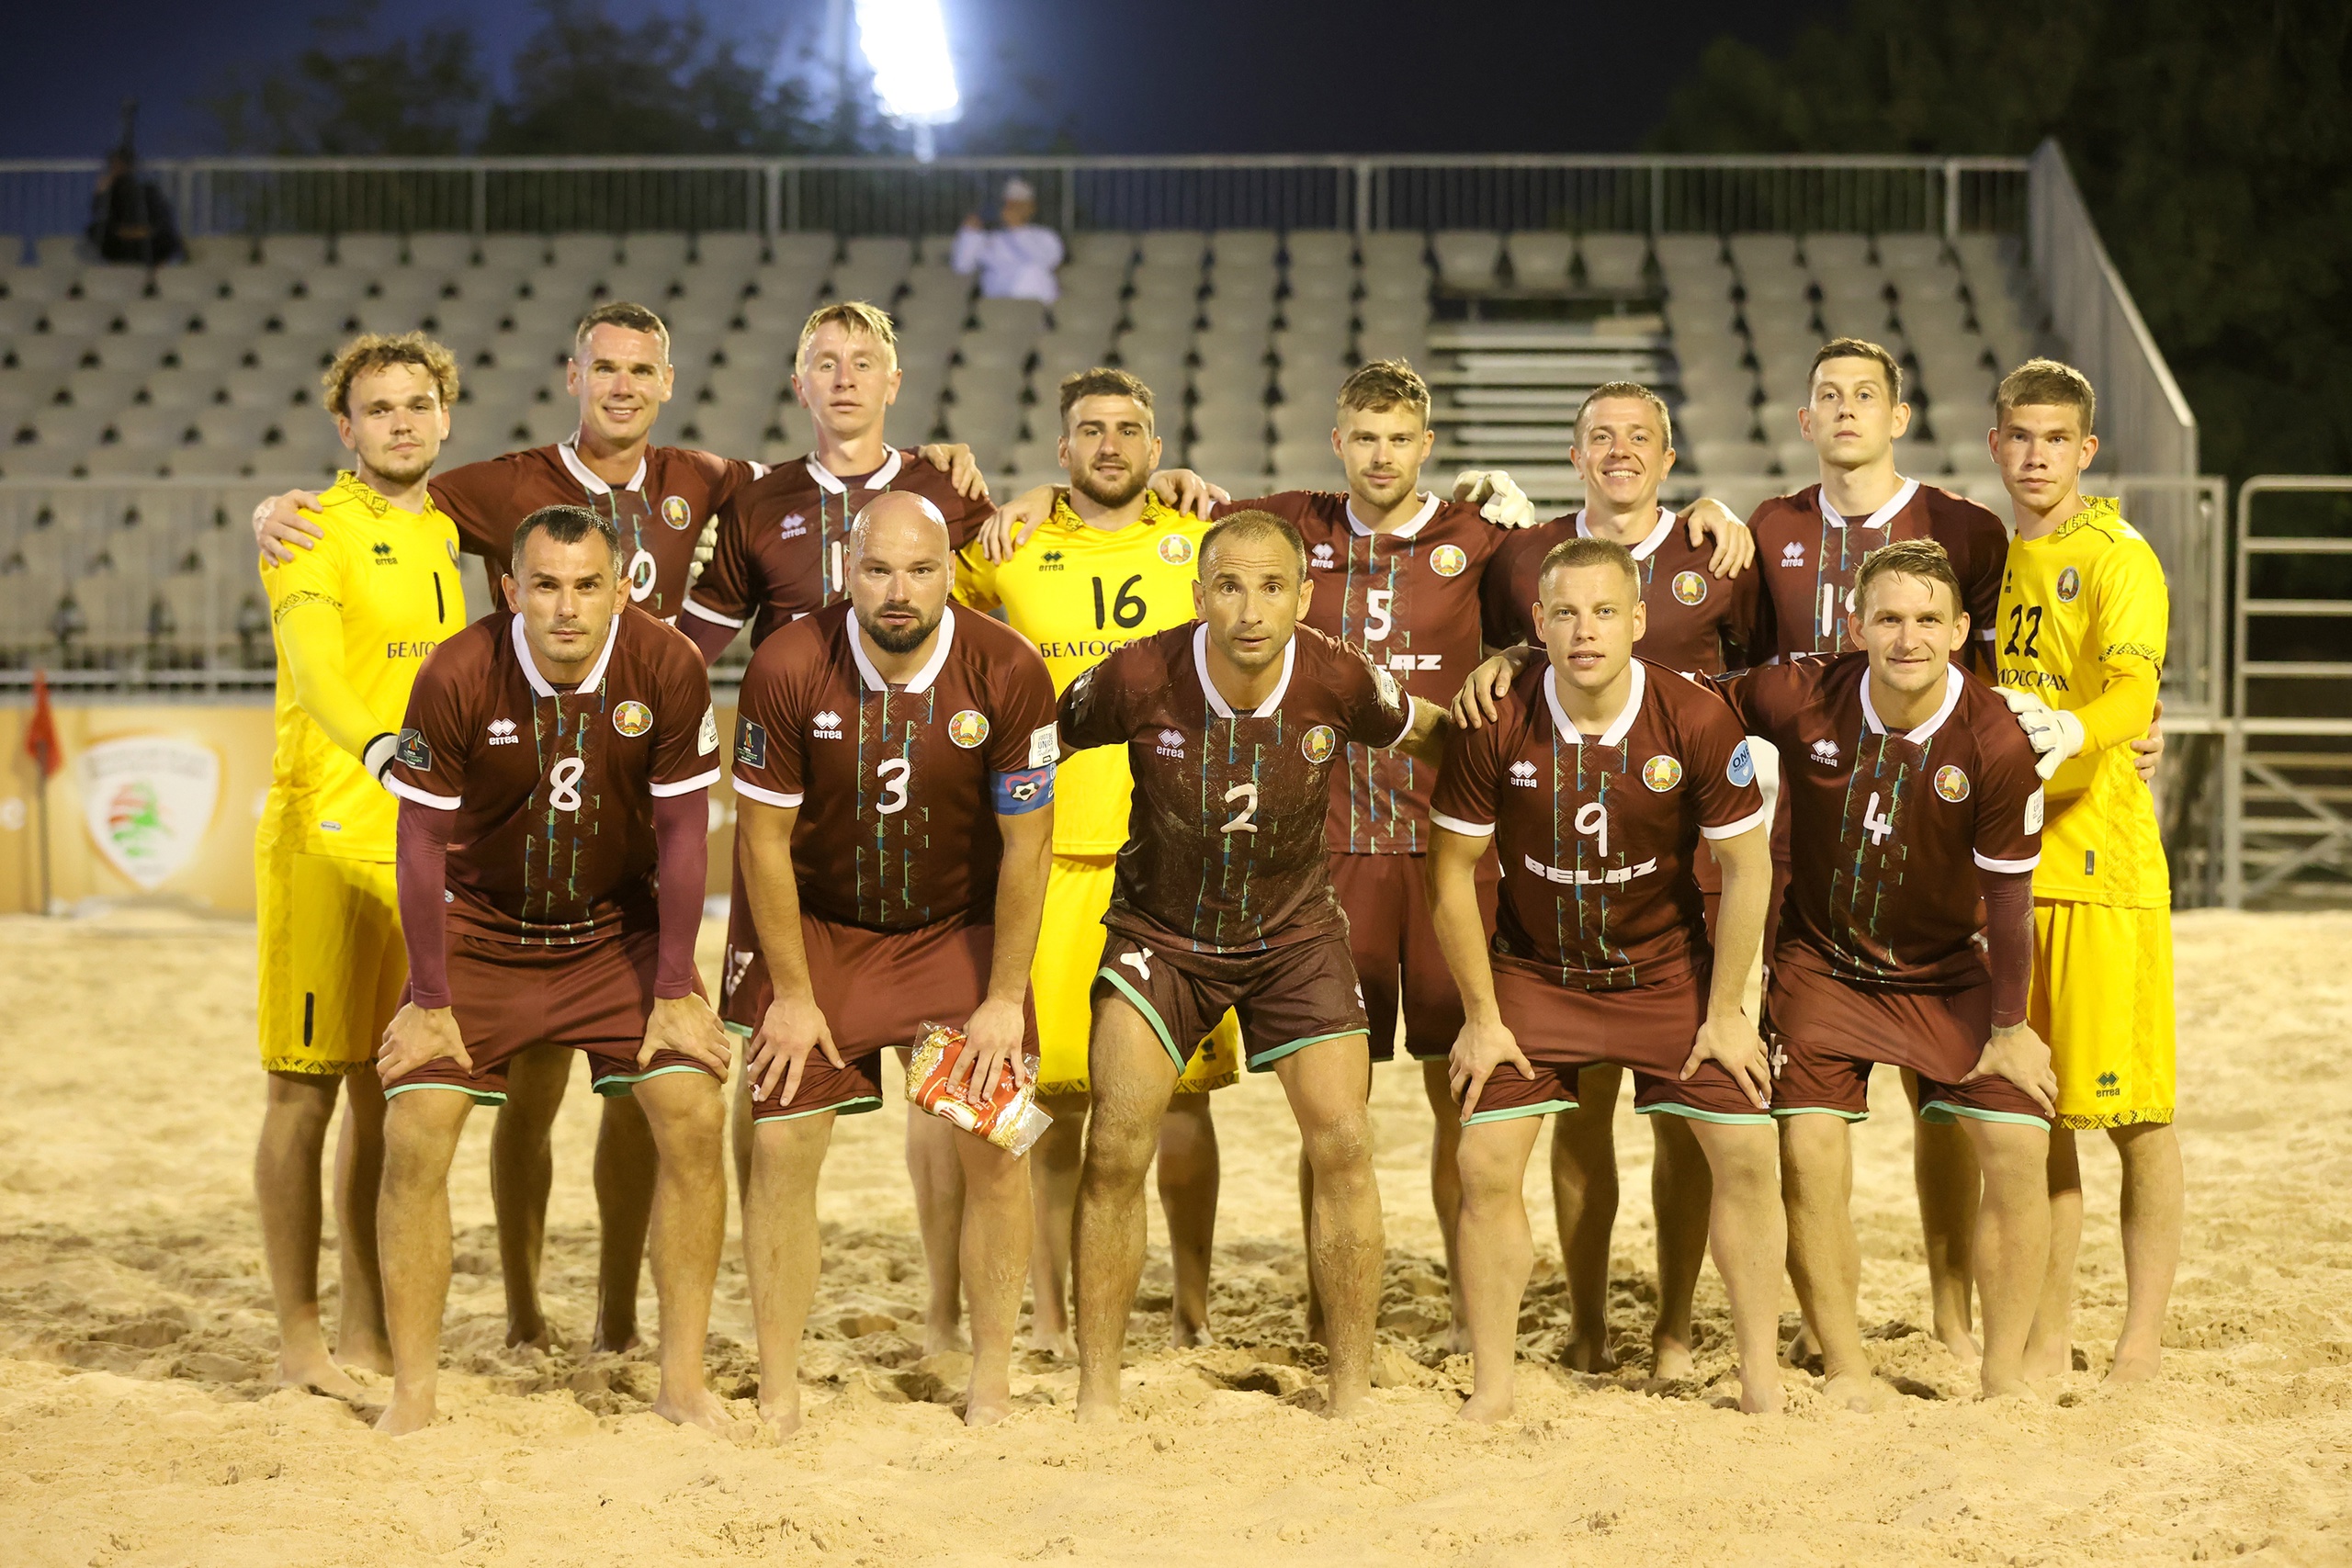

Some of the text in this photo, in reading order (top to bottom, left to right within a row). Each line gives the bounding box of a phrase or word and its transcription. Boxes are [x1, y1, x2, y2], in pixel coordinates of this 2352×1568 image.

[782, 526, 807, 539] errea
[375, 557, 398, 565] errea
[1038, 563, 1064, 571] errea
[1311, 558, 1334, 569] errea
[1781, 558, 1804, 567] errea
[433, 571, 445, 625] 1
[1091, 574, 1147, 630] 16
[1363, 590, 1394, 641] 5
[2004, 604, 2042, 659] 22
[489, 735, 519, 746] errea
[813, 728, 842, 739] errea
[1156, 746, 1184, 759] errea
[1810, 753, 1838, 767] errea
[549, 757, 585, 812] 8
[876, 758, 911, 815] 3
[1510, 777, 1537, 788] errea
[1220, 783, 1258, 833] 2
[1863, 791, 1893, 846] 4
[1574, 802, 1608, 858] 9
[1524, 853, 1657, 885] BELAZ
[2096, 1088, 2120, 1098] errea
